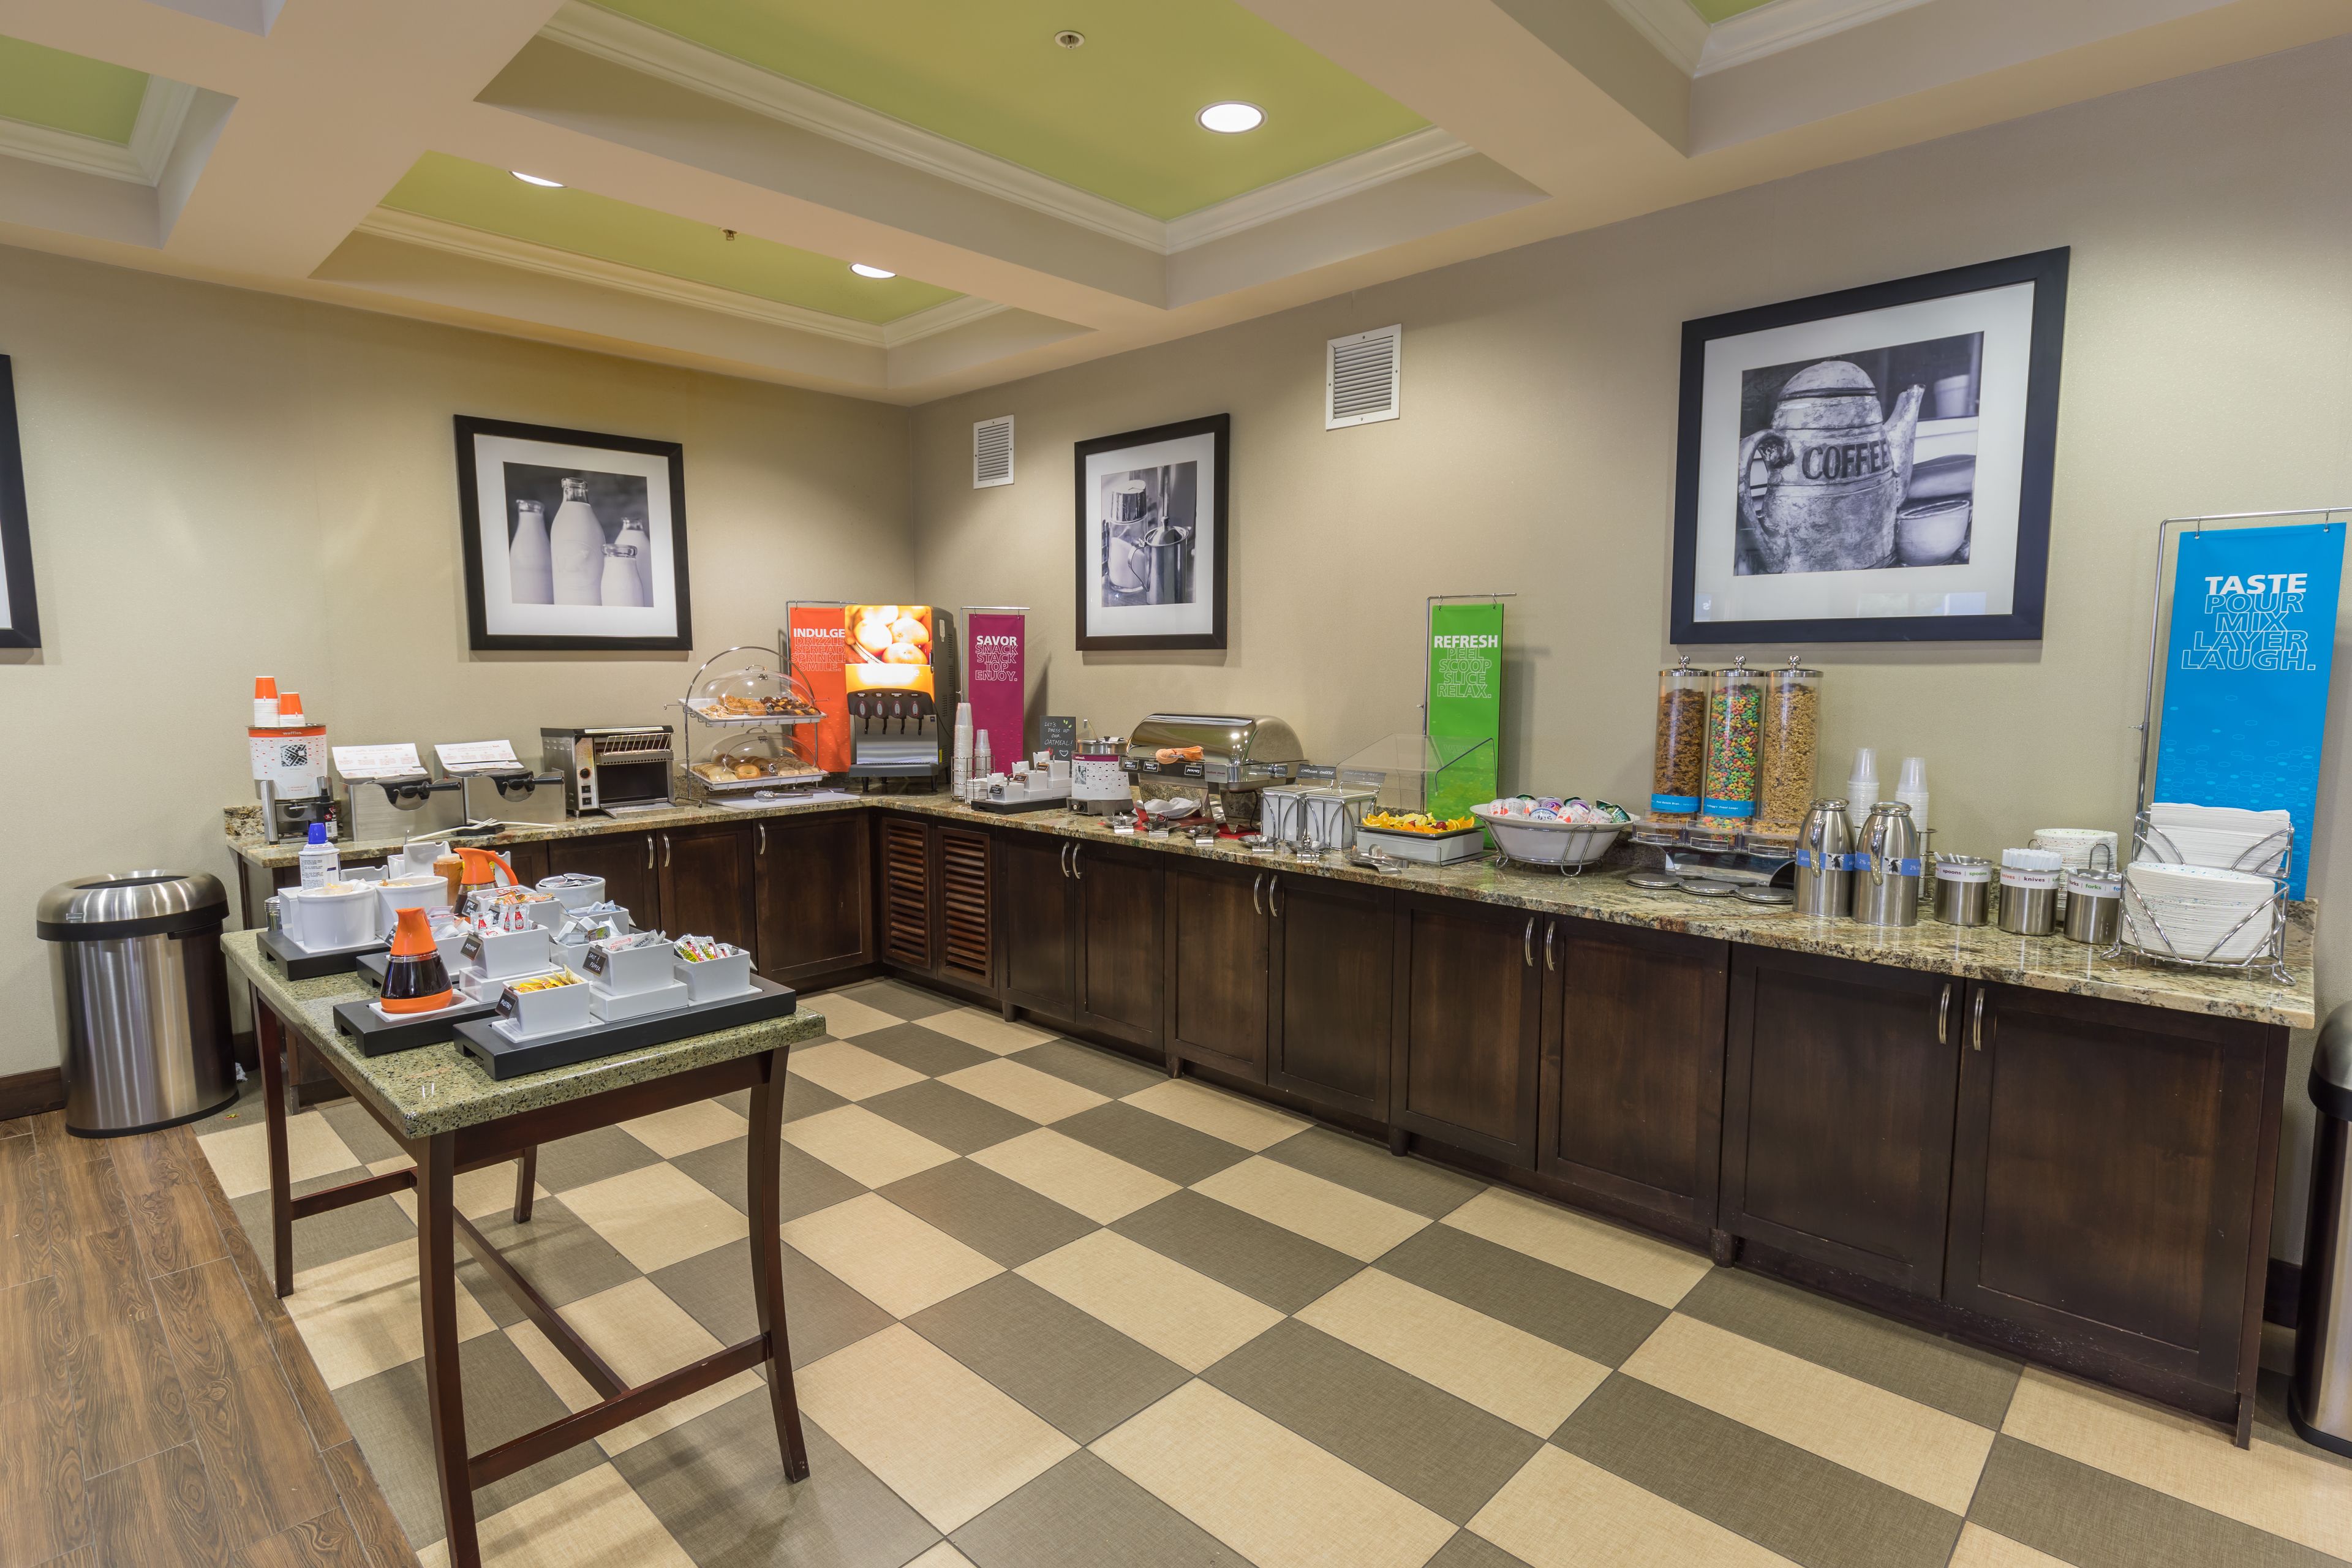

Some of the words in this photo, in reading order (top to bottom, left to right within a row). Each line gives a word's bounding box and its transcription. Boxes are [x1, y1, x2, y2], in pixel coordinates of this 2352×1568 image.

[1802, 438, 1889, 479] COFFEE
[2205, 573, 2307, 594] TASTE
[2205, 592, 2304, 614] POUR
[2215, 611, 2289, 632] MIX
[793, 628, 845, 638] INDULGE
[796, 637, 845, 646] DRIZZLE
[976, 636, 1017, 646] SAVOR
[1434, 635, 1498, 648] REFRESH
[2193, 630, 2309, 650] LAYER
[795, 645, 845, 654] SPREAD
[975, 644, 1018, 655] SNACK
[1447, 647, 1484, 660] PEEL
[977, 653, 1017, 663] STACK
[2181, 650, 2316, 671] LAUGH.
[799, 662, 842, 671] SMILE.
[984, 662, 1009, 672] TOP
[1439, 658, 1492, 673] SCOOP
[975, 670, 1018, 681] ENJOY.
[1444, 671, 1486, 685] SLICE
[1437, 684, 1492, 698] RELAX.
[589, 961, 601, 972] PEPPER
